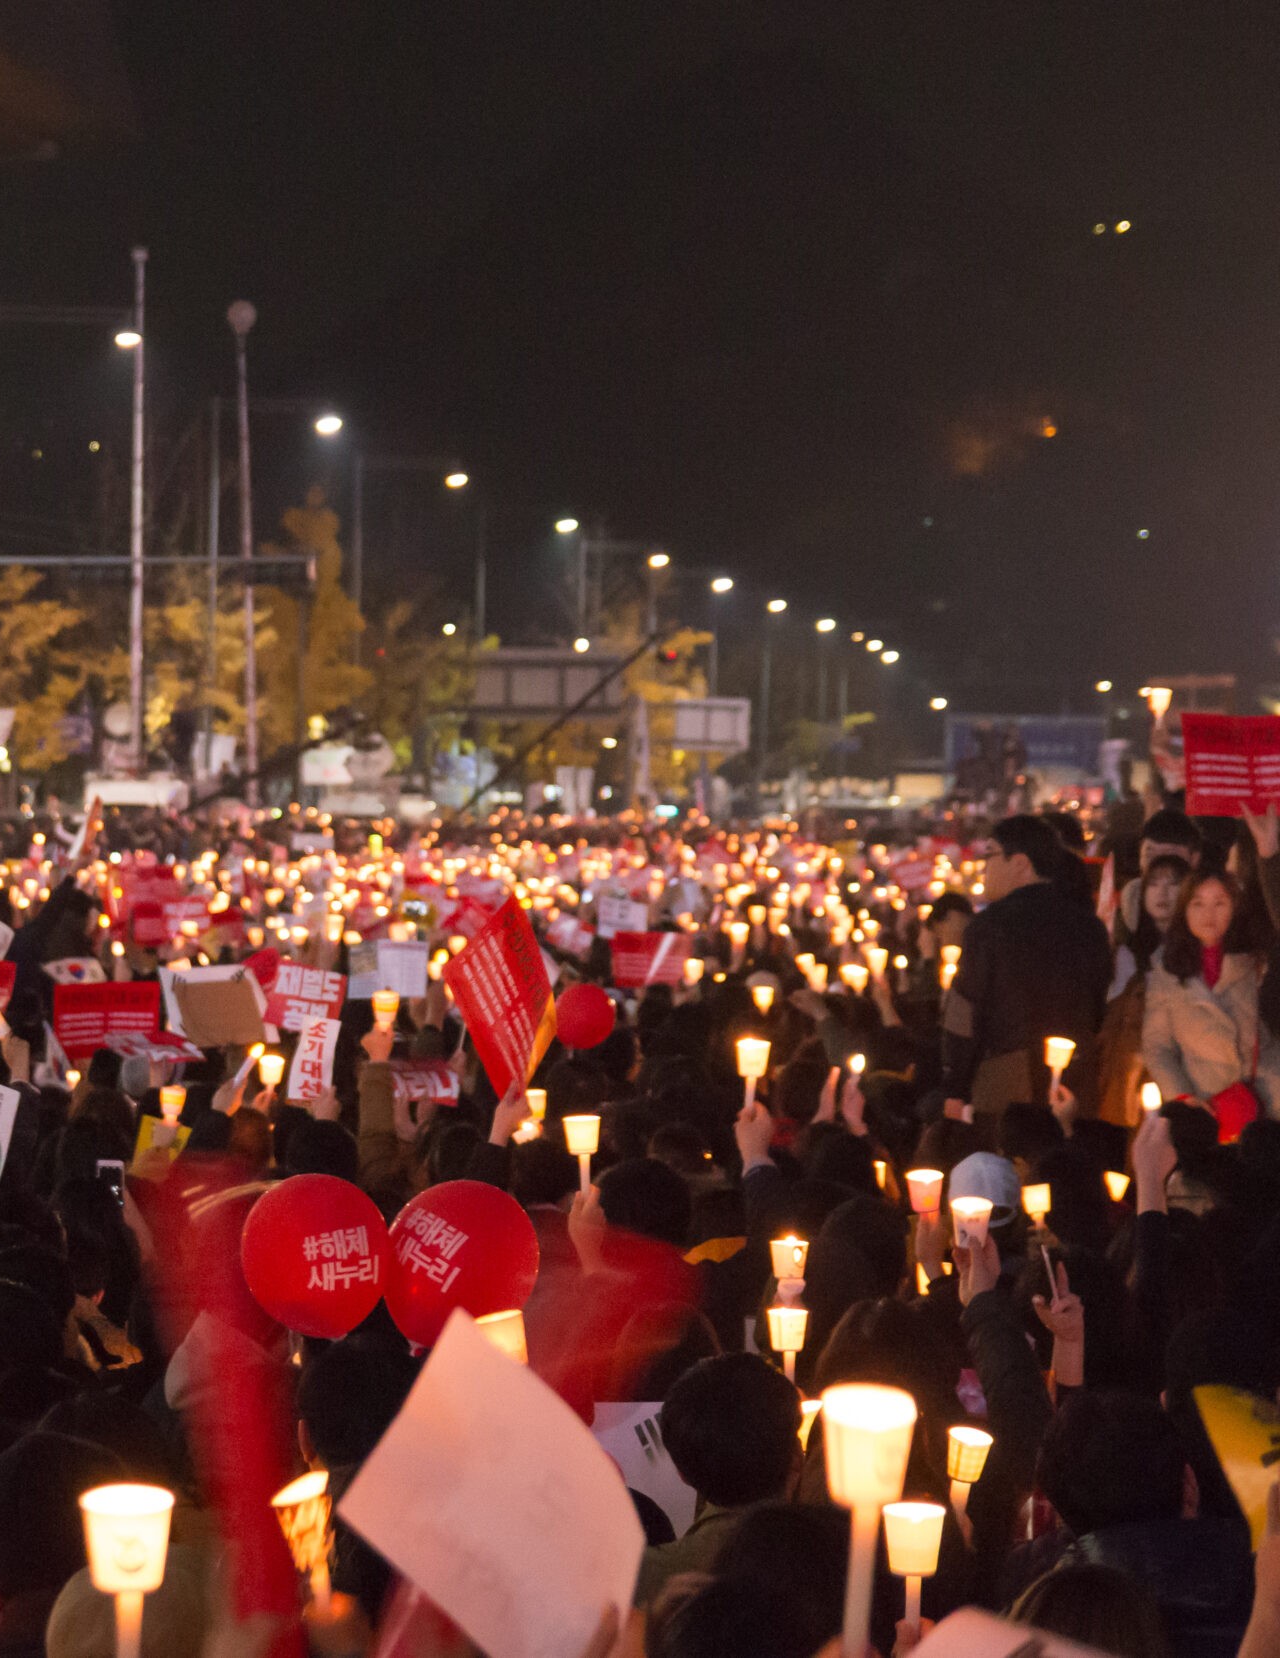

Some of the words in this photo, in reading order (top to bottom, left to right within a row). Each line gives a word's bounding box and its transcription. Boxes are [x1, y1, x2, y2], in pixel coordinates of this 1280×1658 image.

[275, 963, 342, 1003] 재벌도
[297, 1020, 328, 1099] 조기대선
[302, 1225, 369, 1262] #해체
[404, 1207, 470, 1261] #해체
[307, 1254, 380, 1292] 새누리
[395, 1233, 462, 1294] 새누리
